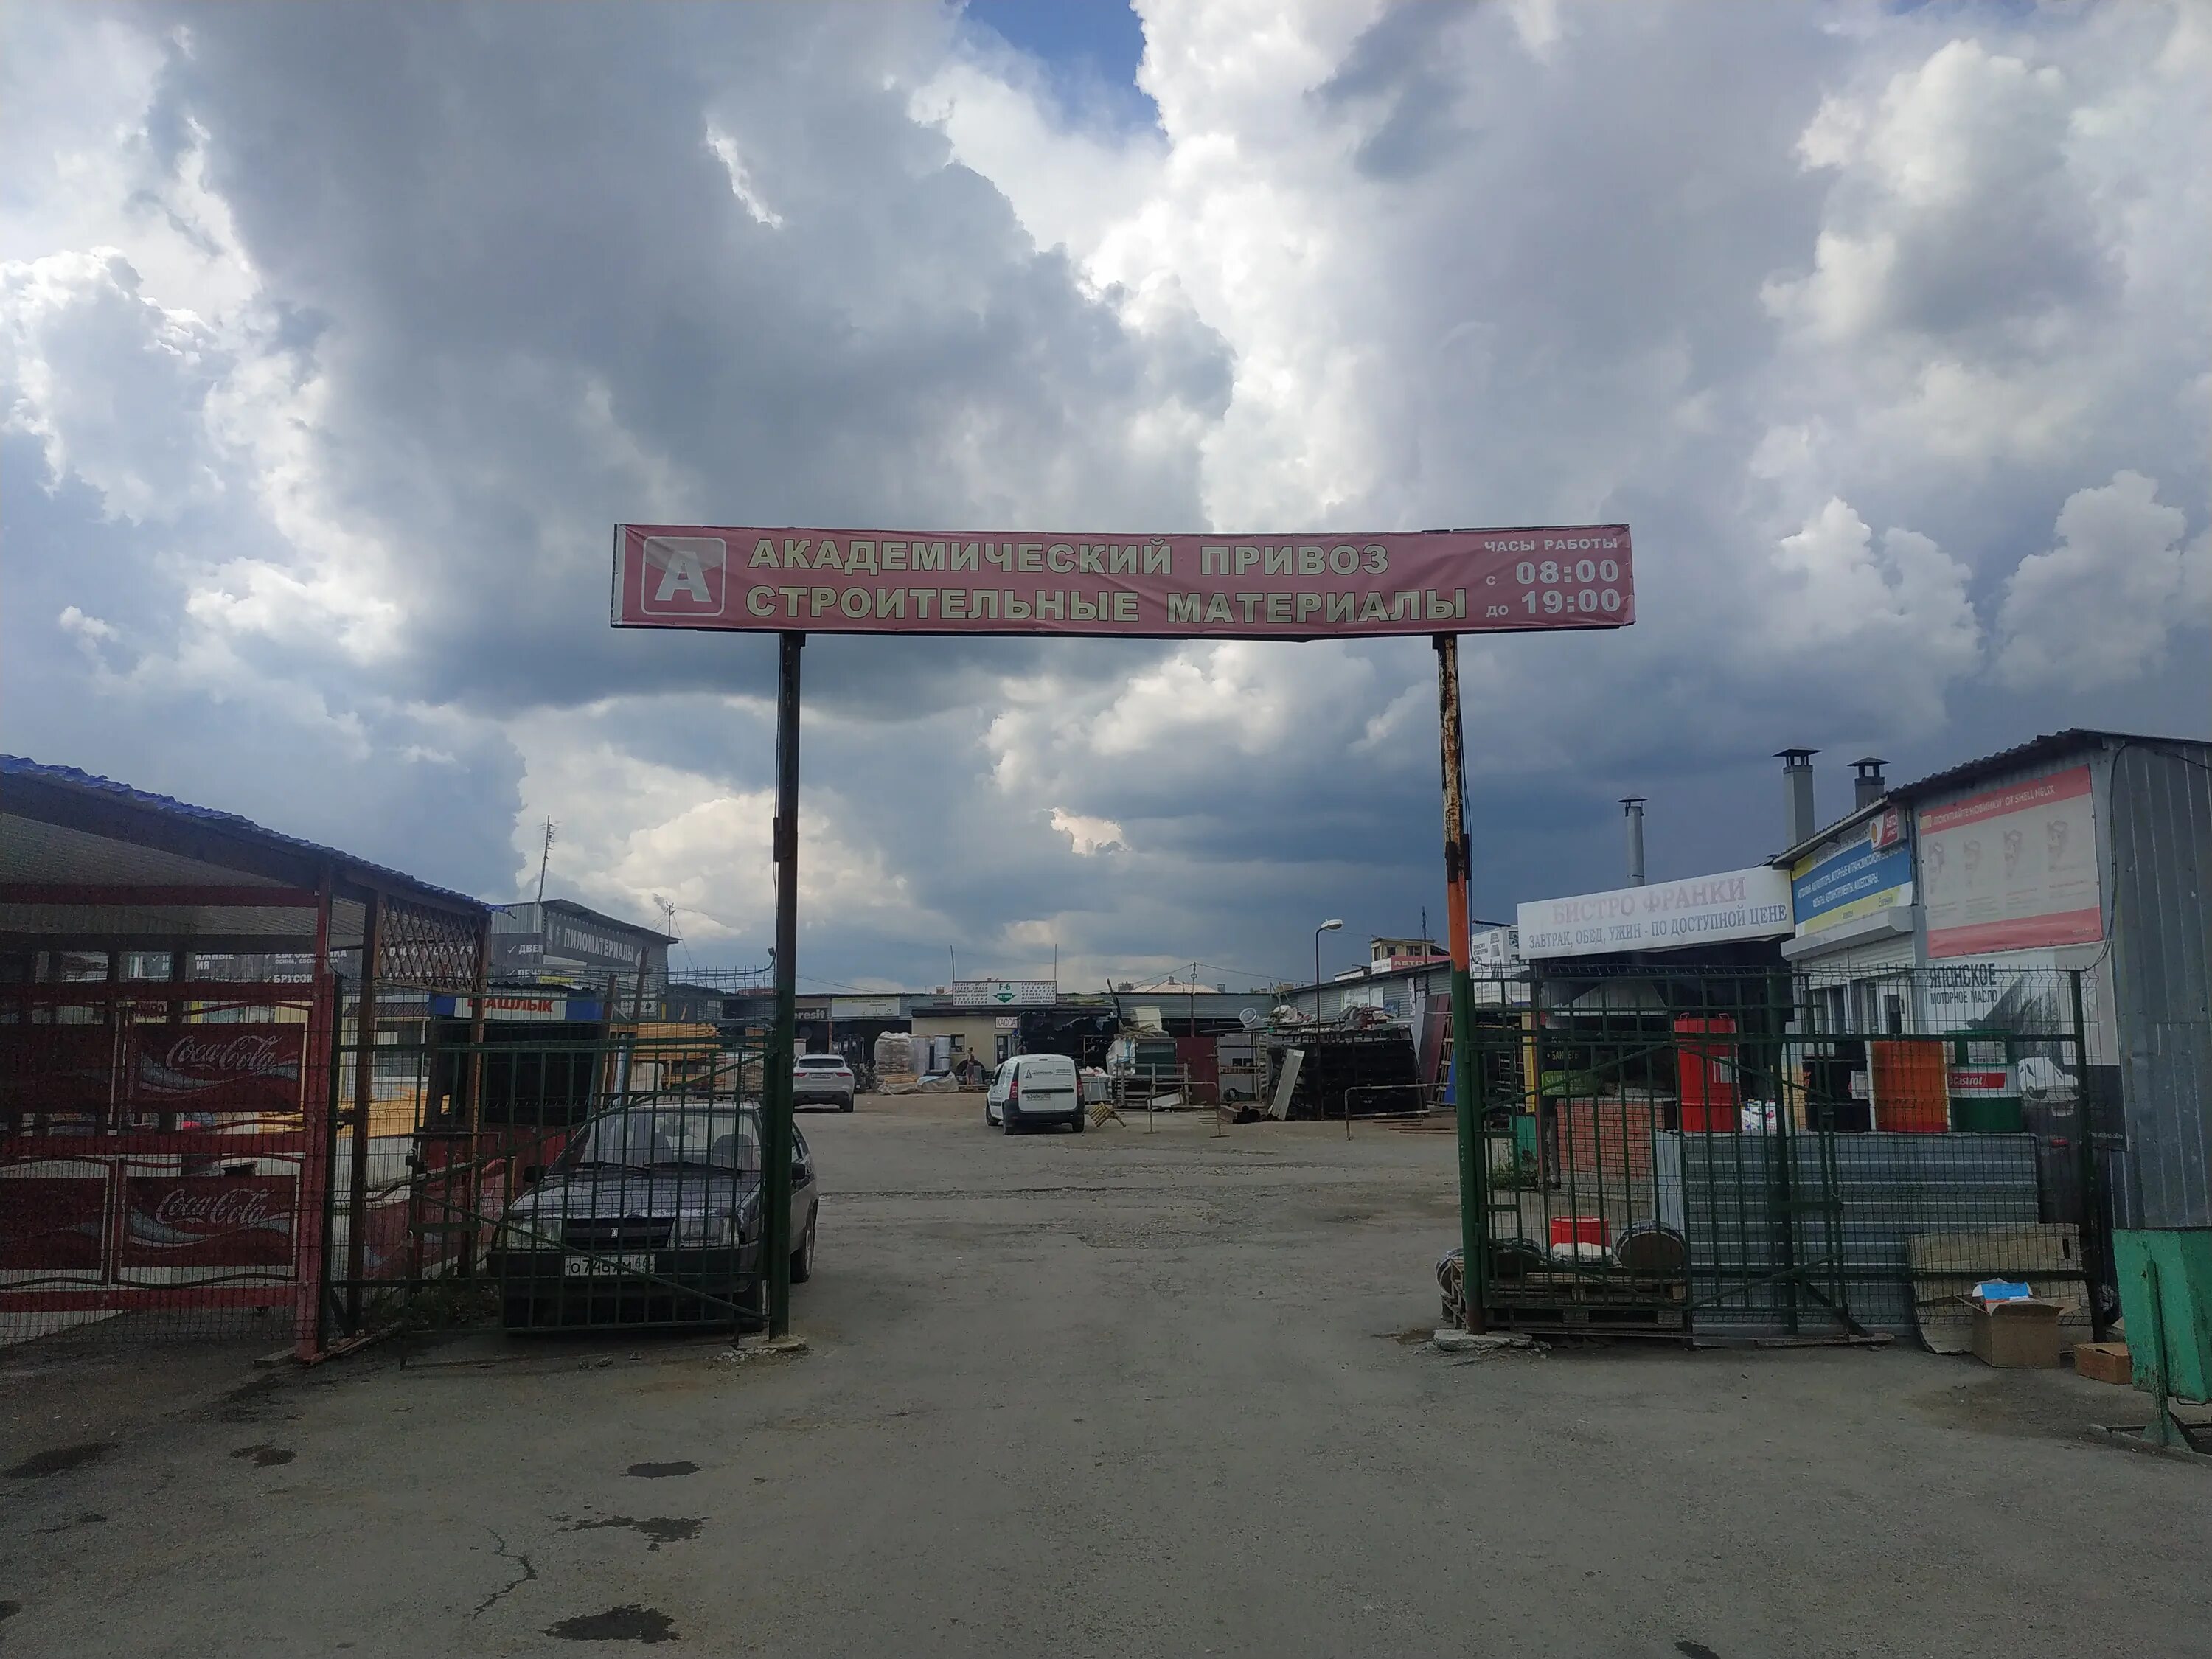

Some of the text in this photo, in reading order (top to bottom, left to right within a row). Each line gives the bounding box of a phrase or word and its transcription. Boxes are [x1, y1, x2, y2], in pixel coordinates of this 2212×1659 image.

[747, 538, 1390, 576] АКАДЕМИЧЕСКИЙ ПРИВОЗ
[1484, 538, 1618, 552] ЧАСЫ РАБОТЫ
[654, 551, 712, 602] А
[1515, 559, 1618, 585] 08:00
[745, 587, 1467, 624] СТРОИТЕЛЬНЫЕ МАТЕРИАЛЫ
[1521, 588, 1621, 614] 19:00
[2014, 790, 2034, 804] SHELL
[1553, 877, 1746, 925] БИСТРО ФРАНКИ
[1529, 931, 1573, 949] ЗАВТРАК,
[1576, 928, 1606, 945] ОБЕД,
[1610, 922, 1641, 942] УЖИН
[1651, 920, 1667, 937] ПО
[1671, 905, 1745, 936] ДОСТУПНОЙ
[1750, 904, 1787, 927] ЦЕНЕ
[563, 928, 633, 962] ПИЛОМАТЕРИАЛЫ
[1930, 963, 1997, 989] ЯПОНСКОЕ
[467, 998, 554, 1013] АШЛЫК
[1930, 990, 1998, 1004] МОТОРНОЕ МАСЛО
[997, 1018, 1016, 1026] КАССА
[165, 1034, 283, 1071] Coca-Cola
[1953, 1076, 1983, 1085] Castrol
[156, 1188, 275, 1224] Coca-Cola
